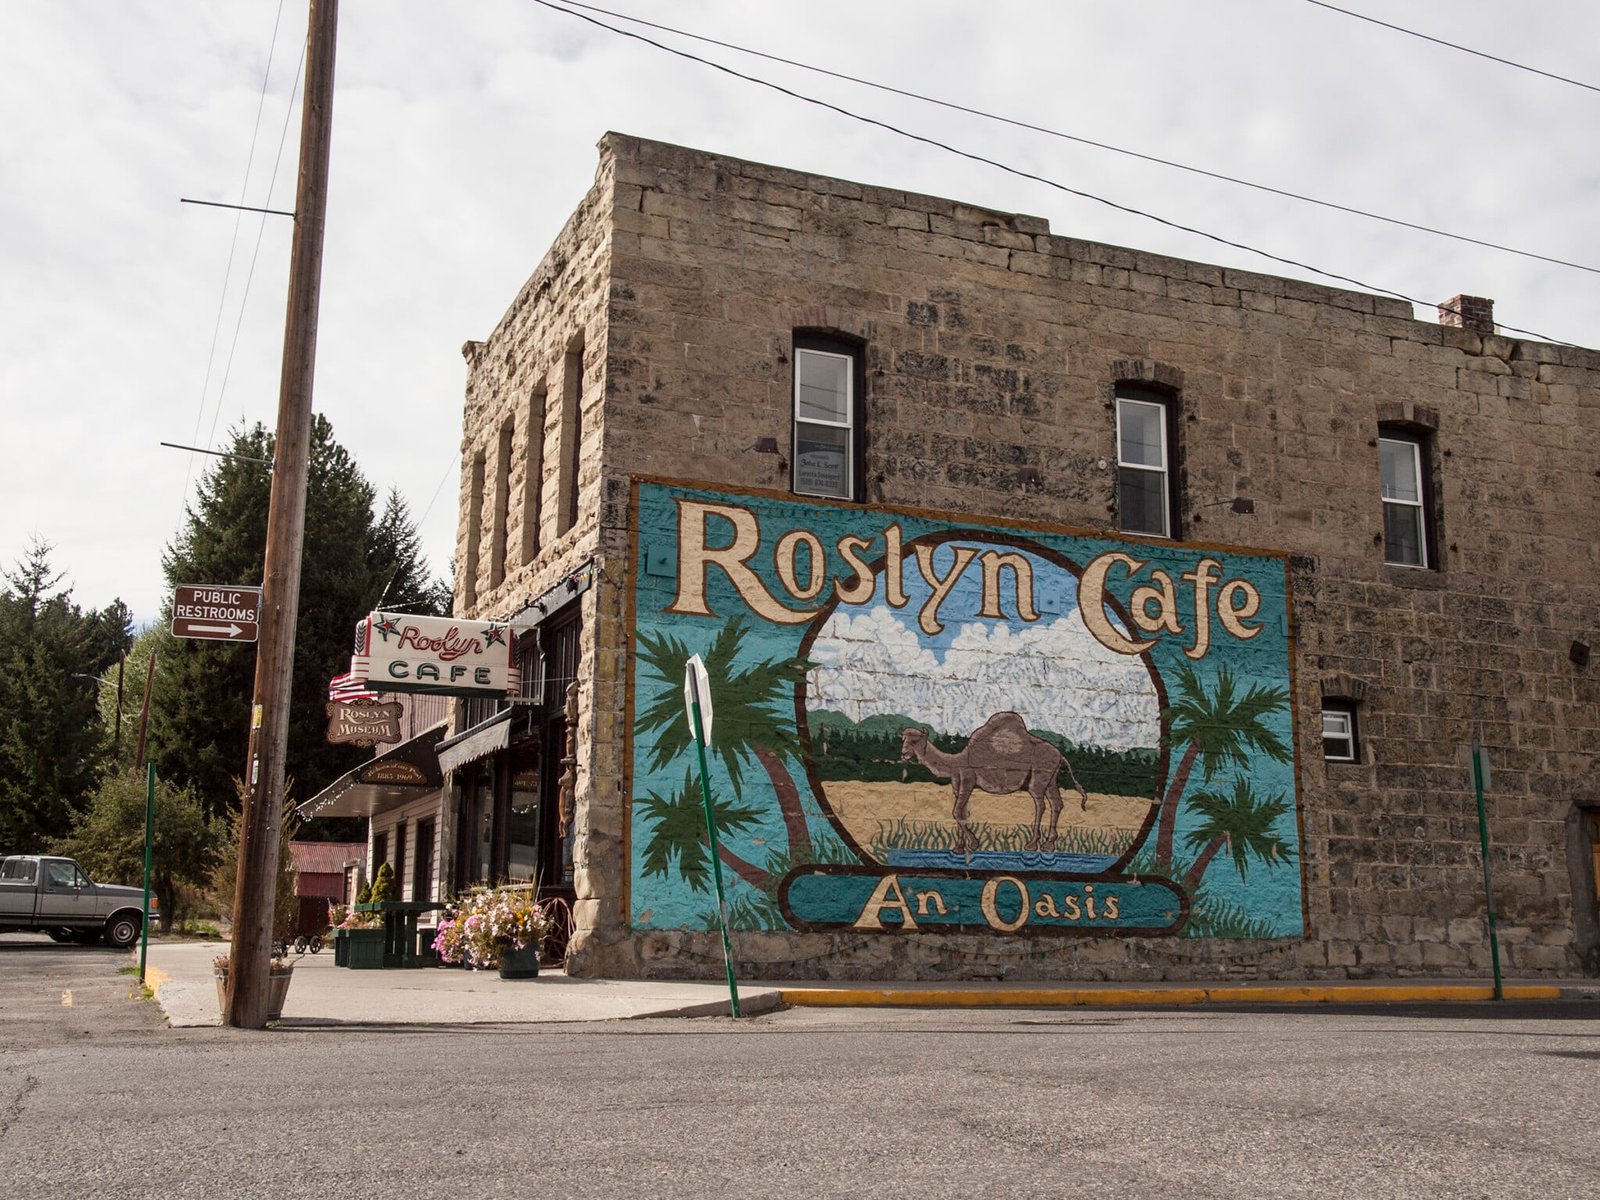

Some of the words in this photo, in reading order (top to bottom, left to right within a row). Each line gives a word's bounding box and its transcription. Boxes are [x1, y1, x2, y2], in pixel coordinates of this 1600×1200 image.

[660, 498, 1042, 636] Roslyn
[1076, 551, 1265, 661] Cafe
[193, 590, 241, 605] PUBLIC
[176, 604, 255, 621] RESTROOMS
[397, 625, 484, 662] Roslyn
[388, 660, 491, 685] CAFE
[340, 708, 390, 724] ROSLYN
[337, 724, 391, 737] MUSEUM
[853, 873, 949, 930] An
[979, 875, 1121, 932] Oasis
